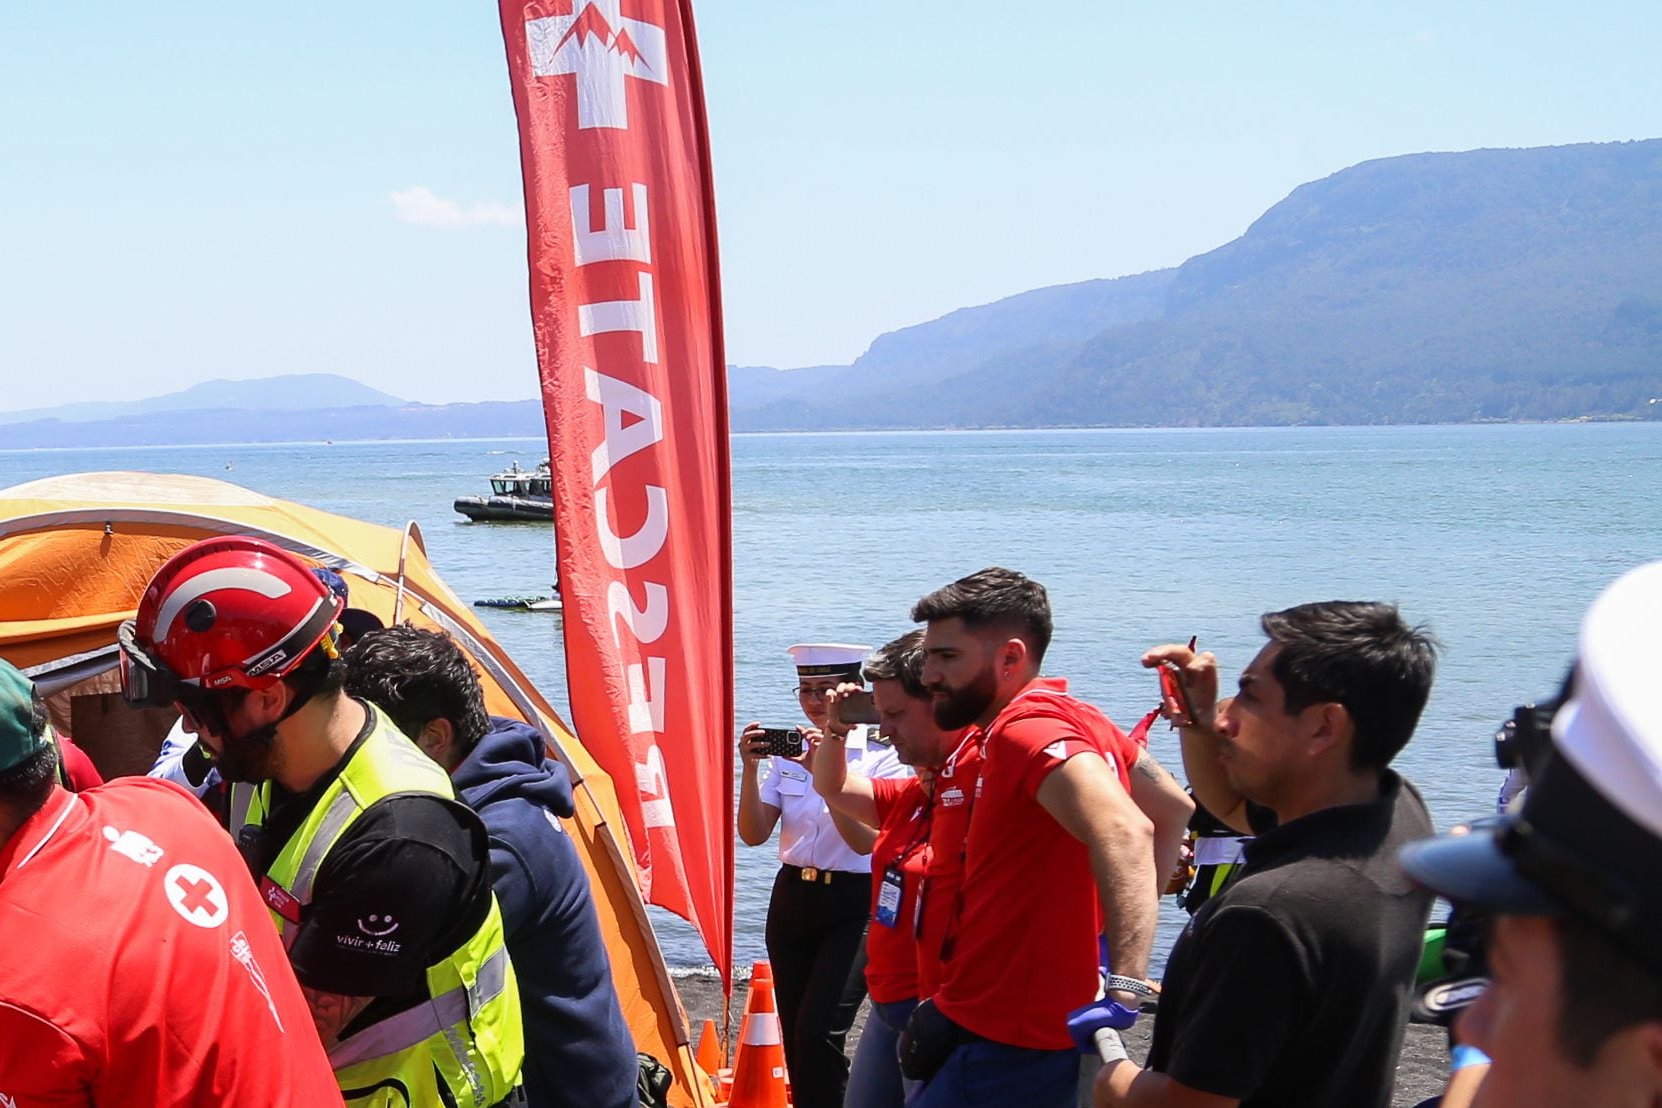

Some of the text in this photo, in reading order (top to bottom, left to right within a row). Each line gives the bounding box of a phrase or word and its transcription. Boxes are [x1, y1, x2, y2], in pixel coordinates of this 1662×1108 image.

[249, 653, 283, 677] MSA
[214, 675, 232, 686] MSA
[338, 935, 364, 947] vivir
[375, 939, 401, 952] feliz
